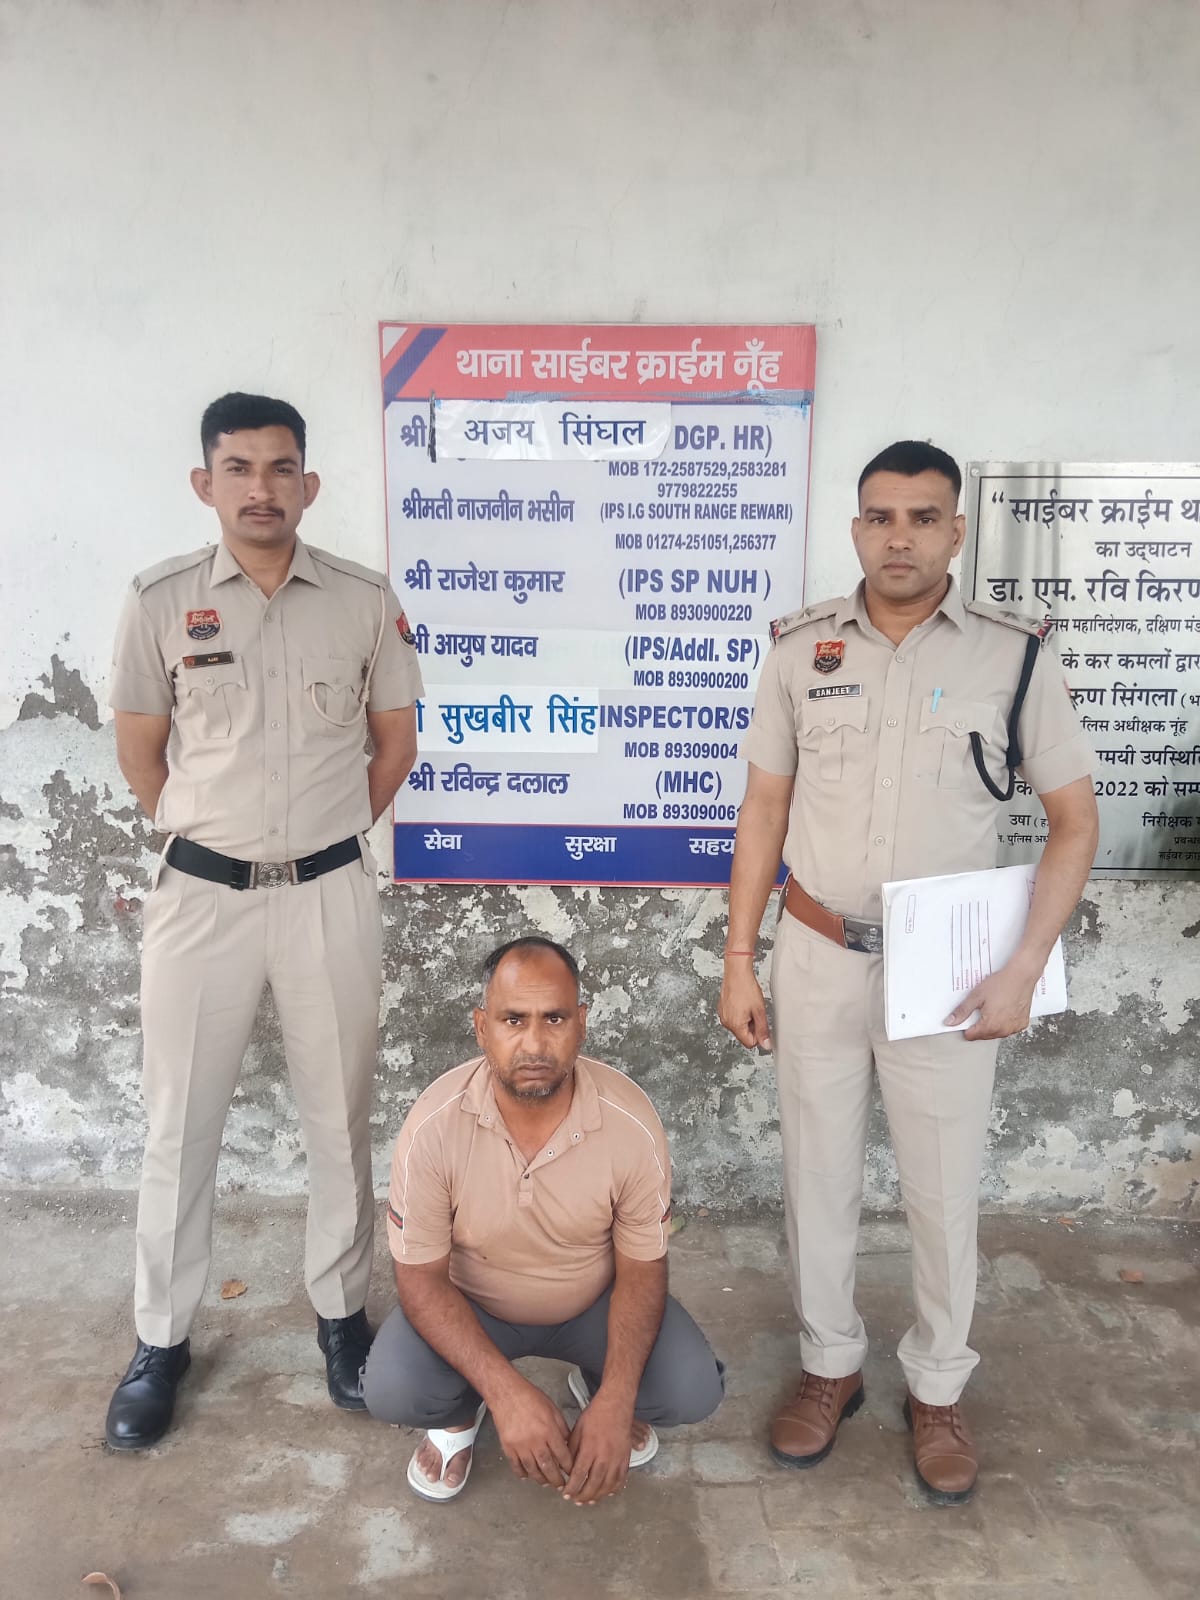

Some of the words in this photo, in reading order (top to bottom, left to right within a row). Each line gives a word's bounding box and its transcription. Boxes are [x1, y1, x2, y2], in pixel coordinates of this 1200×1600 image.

[457, 349, 524, 378] थाना
[531, 338, 630, 382] साईबर
[636, 338, 725, 384] क्राईम
[400, 415, 427, 447] श्री
[464, 419, 535, 446] अजय
[559, 412, 647, 446] सिंघल
[674, 426, 726, 451] DGP.
[733, 425, 773, 457] HR)
[609, 462, 640, 477] MOB
[643, 462, 787, 479] 172-2587529,2583281
[657, 483, 738, 498] 9779822255
[402, 488, 453, 520] श्रीमती
[457, 490, 524, 521] नाजनीन
[528, 490, 575, 523] भसीन
[600, 503, 625, 522] (IPS
[648, 504, 691, 519] SOUTH
[695, 504, 738, 520] RANGE
[741, 504, 793, 524] REWARI)
[1098, 489, 1173, 529] क्राईम
[1181, 499, 1200, 522] थ
[615, 534, 643, 550] MOB
[647, 534, 776, 553] 01274-251051,256377
[1095, 541, 1121, 558] का
[404, 559, 433, 591] श्री
[437, 563, 498, 592] राजेश
[503, 568, 565, 603] कुमार
[619, 568, 664, 598] (IPS
[671, 569, 699, 593] SP
[987, 578, 1023, 601] डा.
[1032, 578, 1076, 609] एम.
[1084, 569, 1130, 602] रवि
[635, 604, 666, 620] MOB
[670, 604, 752, 622] 8930900220
[1146, 614, 1182, 635] दक्षिण
[434, 633, 486, 668] आयुष
[491, 635, 539, 658] यादव
[625, 636, 721, 666] (IPS/Addl.
[727, 638, 761, 670] SP)
[1061, 647, 1080, 669] के
[1084, 654, 1113, 669] कर
[1117, 648, 1172, 670] कमलों
[1175, 654, 1200, 673] द्वार
[633, 670, 665, 687] MOB
[668, 671, 748, 689] 8930900200
[816, 687, 849, 696] SANJEET
[1111, 681, 1178, 707] सिंगला
[438, 694, 533, 745] सुखबीर
[548, 697, 598, 736] सिंह
[600, 705, 755, 730] INSPECTOR/S
[1080, 715, 1110, 732] लिस
[1112, 715, 1166, 734] अधीक्षक
[624, 741, 659, 758] MOB
[664, 742, 738, 759] 89309004
[408, 762, 435, 792] श्री
[441, 764, 500, 797] रविन्द्र
[507, 773, 569, 795] दलाल
[655, 770, 722, 801] (MHC)
[1143, 775, 1169, 797] को
[623, 803, 658, 819] MOB
[662, 804, 741, 821] 89309006
[1008, 814, 1032, 826] उषा
[1142, 811, 1193, 828] निरीक्षक
[424, 829, 461, 850] सेवा
[565, 836, 616, 860] सुरक्षा
[689, 832, 736, 855] सहय
